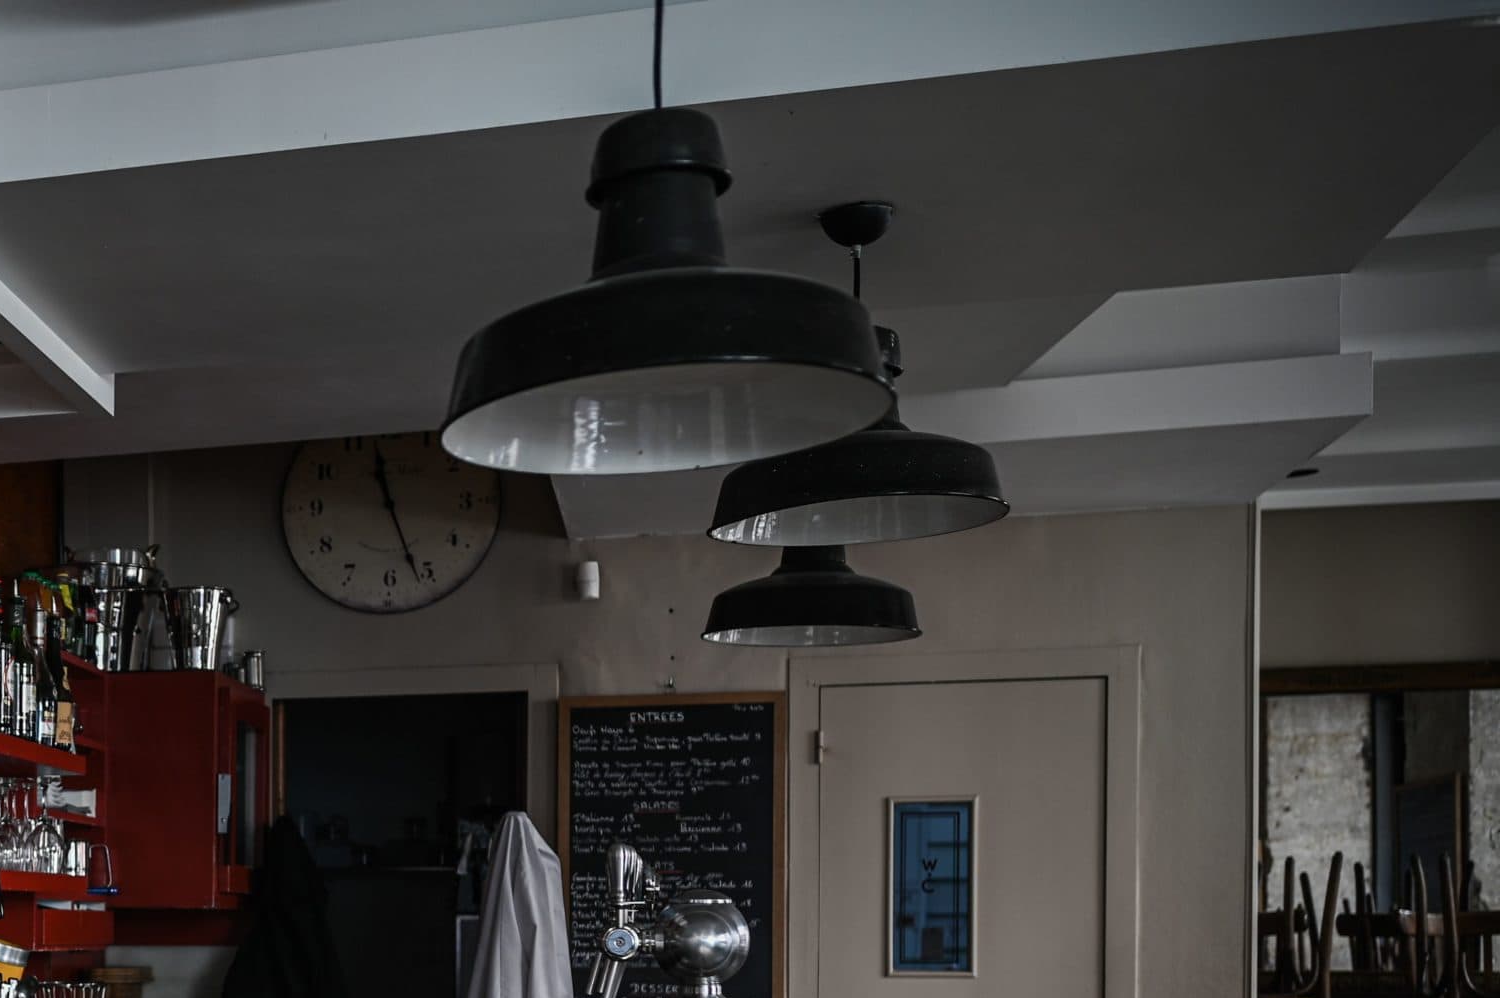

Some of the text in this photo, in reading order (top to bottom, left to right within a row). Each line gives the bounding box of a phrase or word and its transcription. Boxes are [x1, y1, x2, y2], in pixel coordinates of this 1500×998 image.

[310, 498, 323, 516] 9
[320, 535, 333, 553] 8
[343, 563, 356, 583] 7
[384, 569, 396, 587] 6
[421, 561, 434, 580] 5
